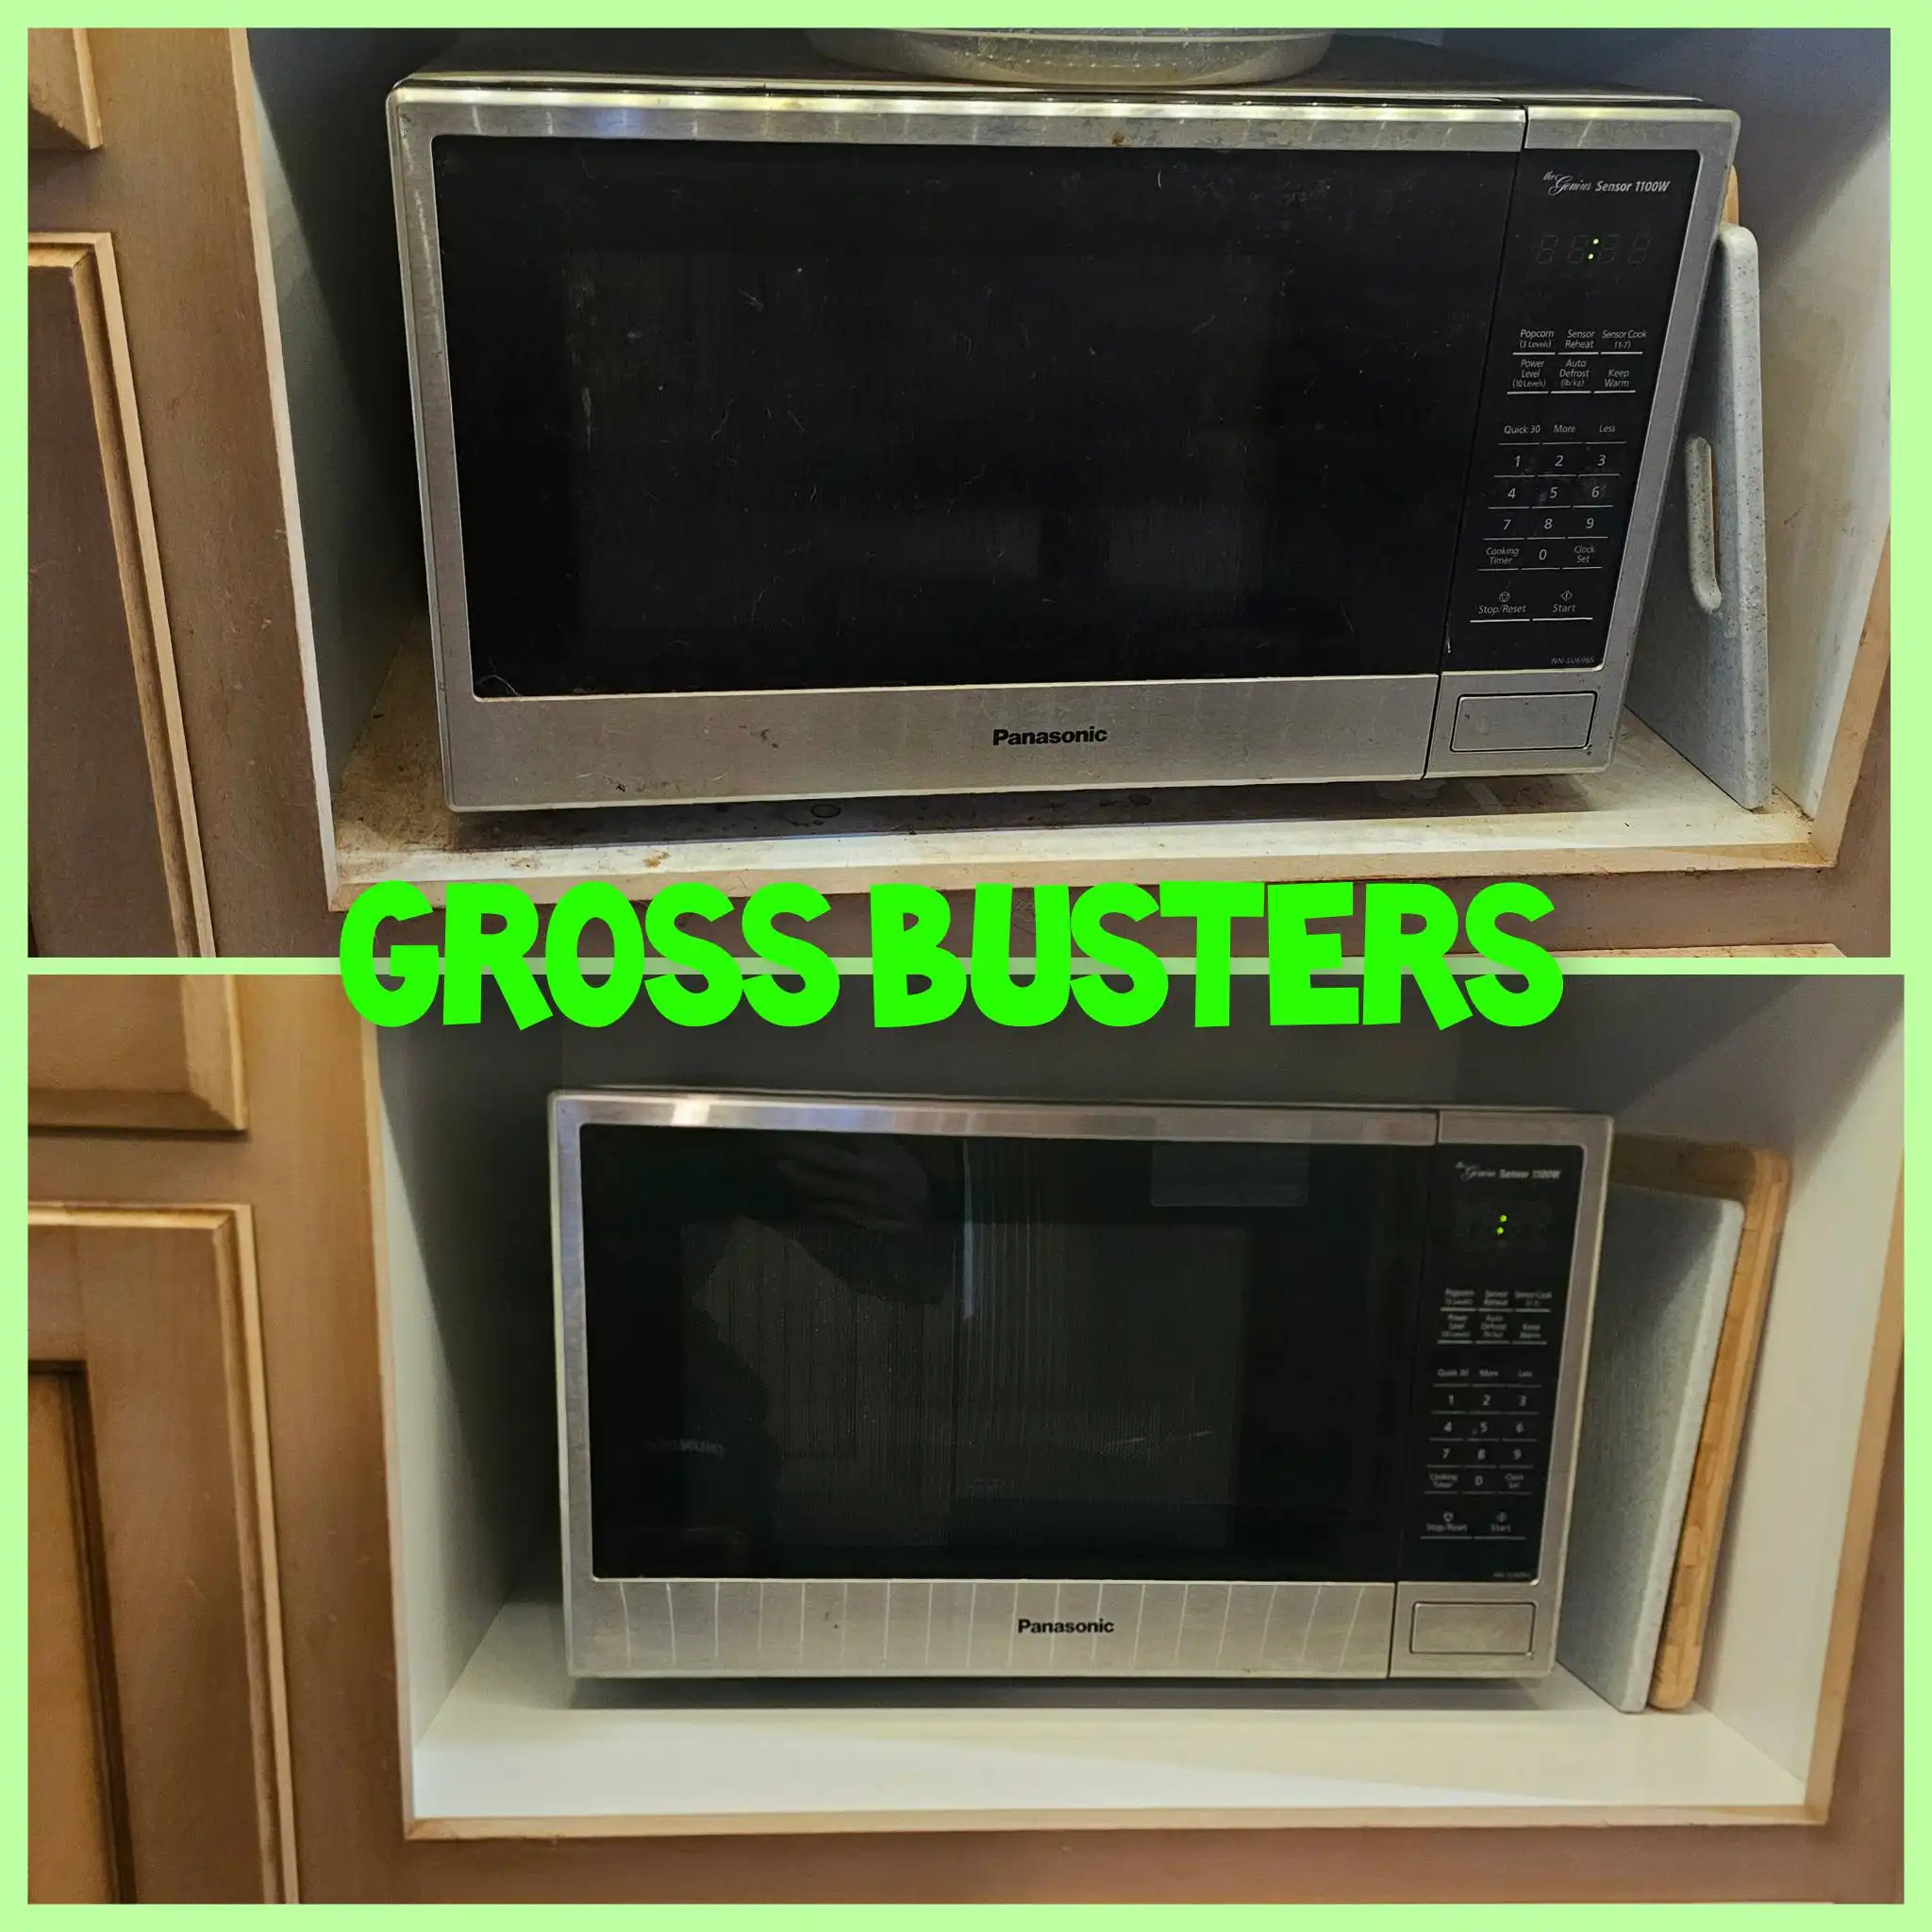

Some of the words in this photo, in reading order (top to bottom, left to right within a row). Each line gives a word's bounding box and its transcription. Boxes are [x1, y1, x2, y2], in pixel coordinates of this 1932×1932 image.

[1542, 170, 1557, 181] the
[1548, 174, 1591, 196] Genius
[1595, 180, 1632, 192] Sensor
[1635, 180, 1671, 192] 1100W
[1520, 329, 1555, 339] Popcorn
[1567, 329, 1595, 339] Sensor
[1602, 329, 1627, 339] Sensor
[1627, 329, 1646, 339] Cook
[1565, 340, 1594, 349] Reheat
[1521, 358, 1544, 368] Power
[1566, 358, 1587, 368] Auto
[1522, 369, 1541, 377] Level
[1559, 369, 1590, 377] Defrost
[1608, 369, 1630, 378] Keep
[1604, 378, 1629, 388] Warm
[1504, 425, 1528, 434] Quick
[1530, 425, 1541, 433] 30
[1554, 425, 1575, 433] More
[1599, 425, 1616, 433] Less
[1515, 455, 1521, 467] 1
[1555, 455, 1563, 467] 2
[1597, 455, 1606, 466] 3
[1507, 487, 1516, 498] 4
[1549, 487, 1557, 498] 5
[1591, 487, 1599, 497] 6
[1504, 519, 1510, 530] 7
[1544, 519, 1553, 529] 8
[1586, 518, 1594, 529] 9
[1486, 547, 1519, 557] Cooking
[1539, 549, 1547, 560] 0
[1574, 545, 1595, 554] Clock
[1490, 556, 1512, 564] Timer
[1576, 555, 1590, 563] Set
[1478, 604, 1526, 614] Stop/Reset
[1553, 604, 1575, 612] Start
[992, 725, 1108, 745] Panasonic
[1448, 1394, 1454, 1405] 1
[1483, 1394, 1491, 1406] 2
[1519, 1395, 1527, 1406] 3
[1443, 1422, 1452, 1432] 4
[1480, 1422, 1488, 1432] 5
[1516, 1423, 1524, 1433] 6
[1441, 1448, 1450, 1458] 7
[1477, 1449, 1486, 1460] 8
[1514, 1449, 1522, 1460] 9
[1018, 1618, 1115, 1634] Panasonic
